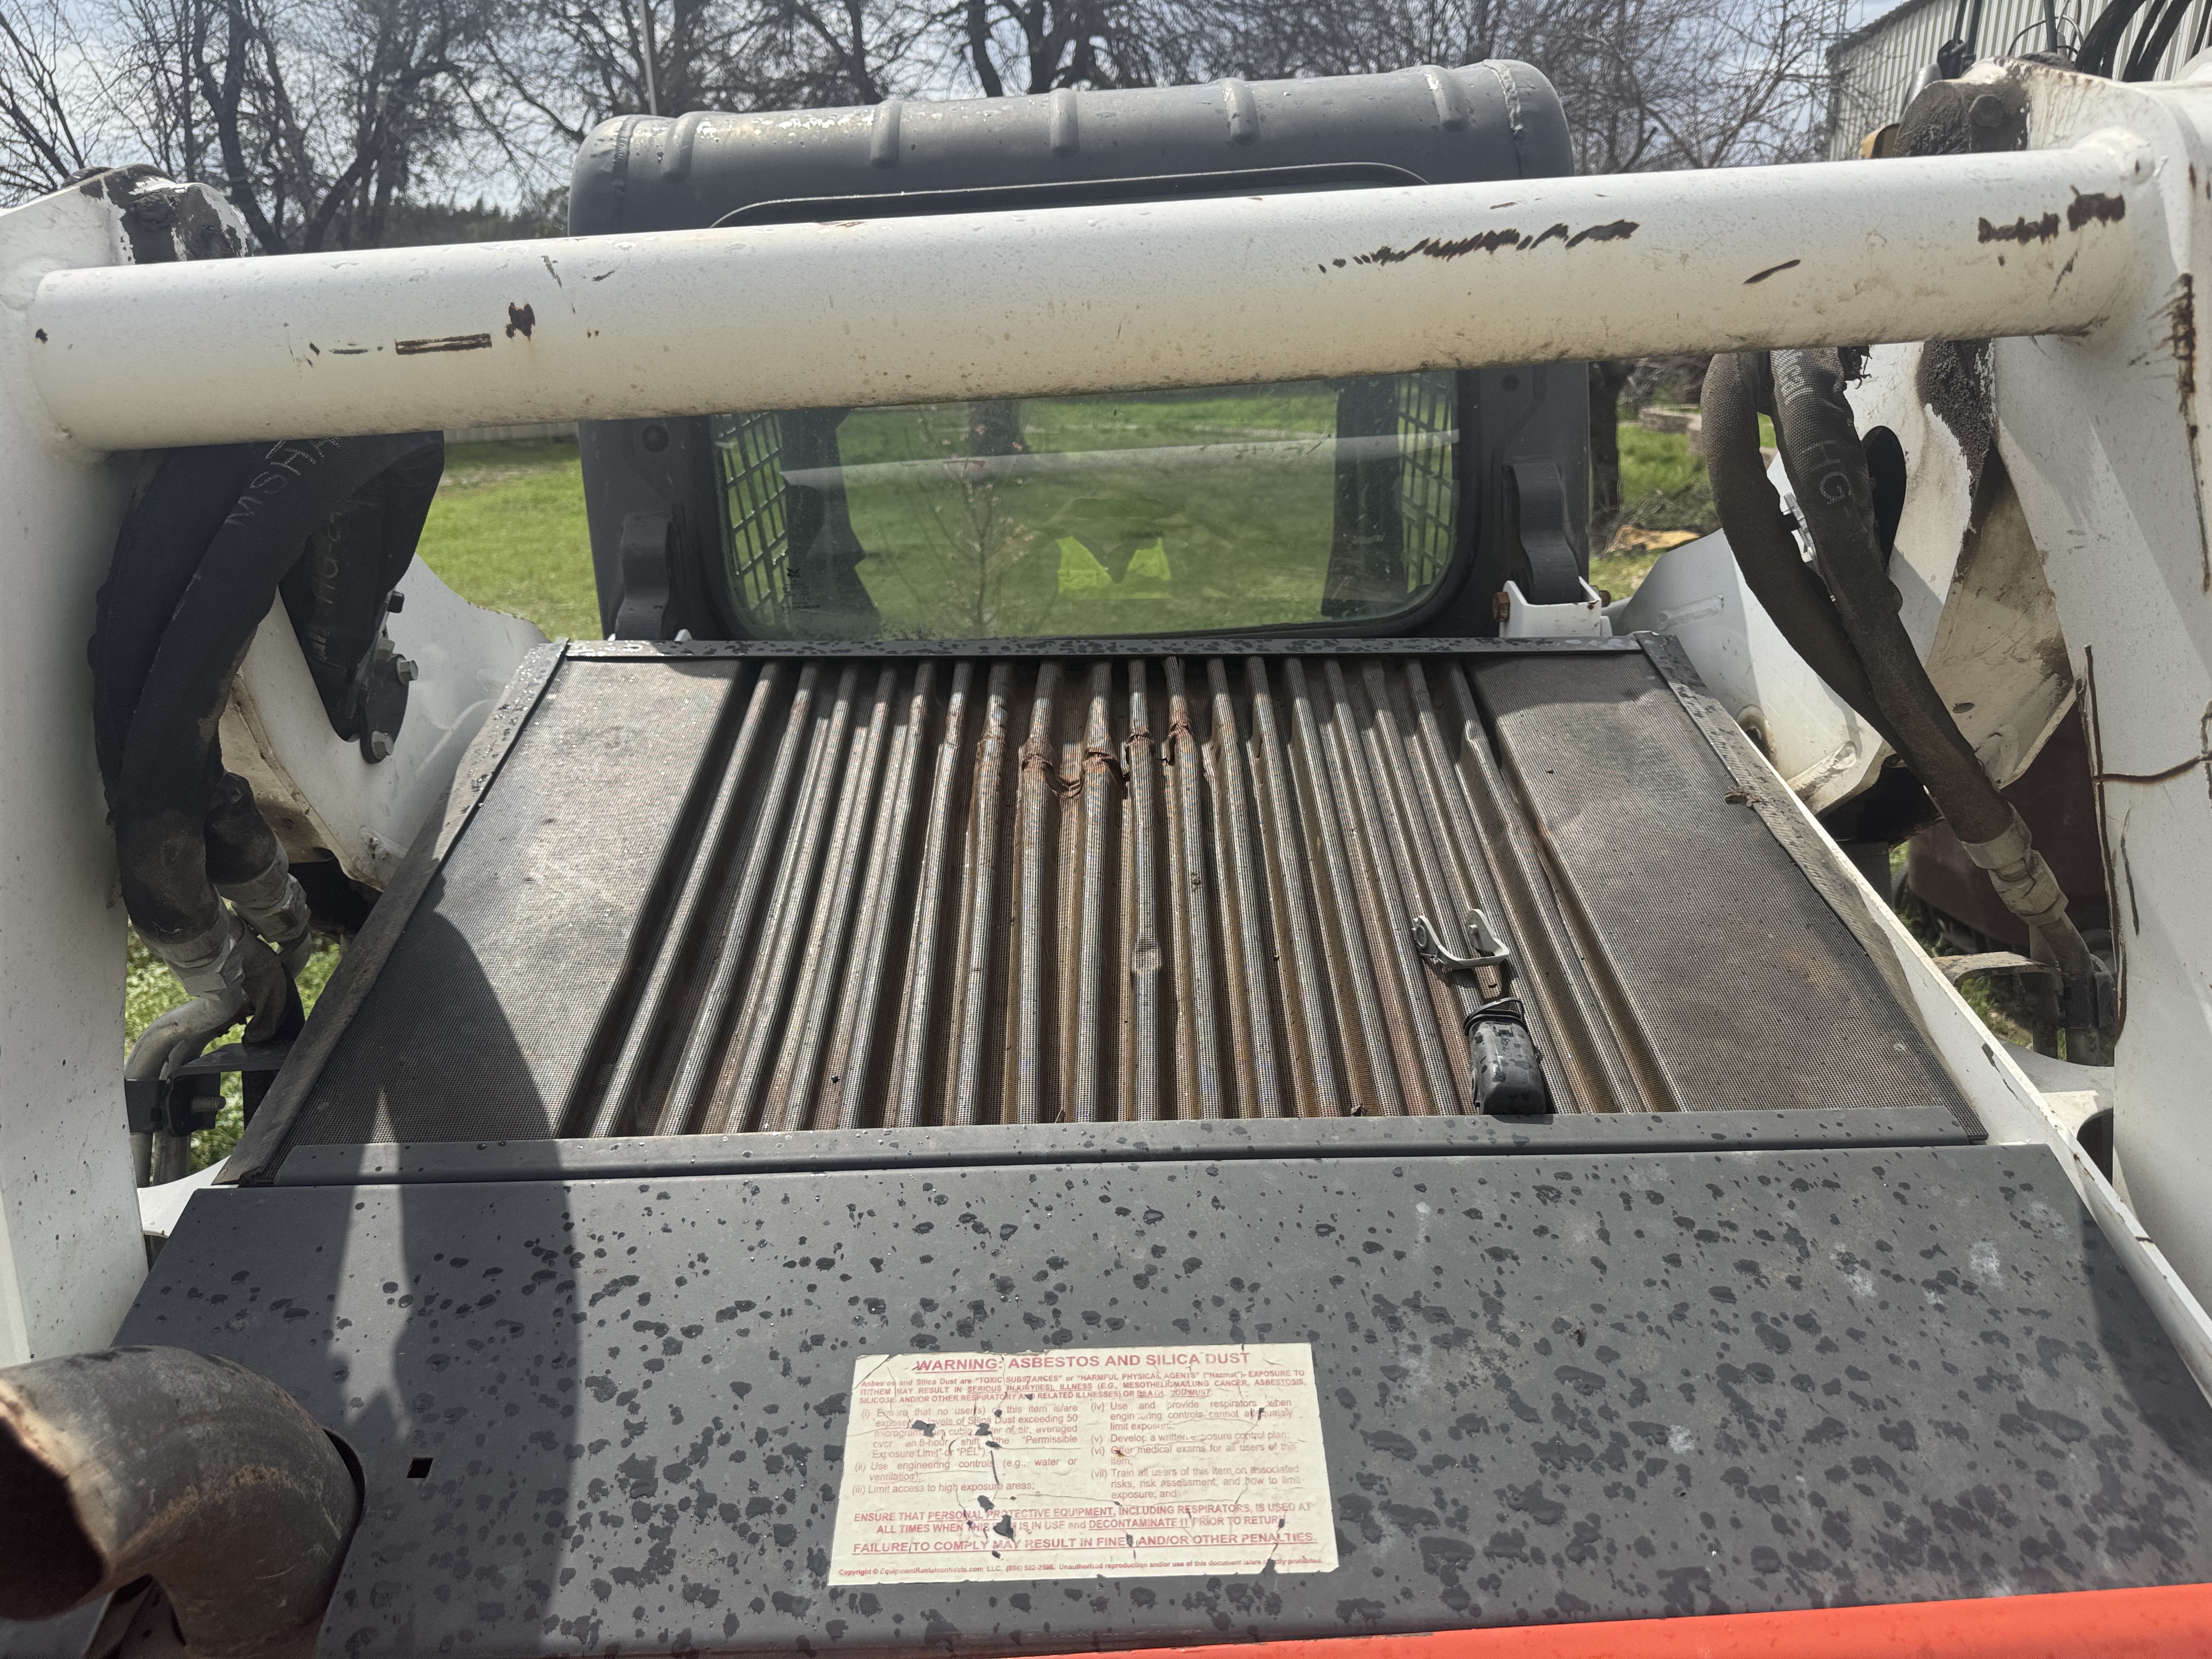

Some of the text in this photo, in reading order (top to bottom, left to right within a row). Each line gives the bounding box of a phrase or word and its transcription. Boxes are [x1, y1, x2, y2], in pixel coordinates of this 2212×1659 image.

[915, 1352, 1250, 1371] WARNING: ASBESTOS AND SILICA DUST
[1097, 1382, 1118, 1390] (E.G.,
[1254, 1378, 1306, 1386] ASBESTOSIS,
[1075, 1390, 1121, 1399] ILLNESSES)
[861, 1408, 871, 1419] (i)
[914, 1407, 932, 1415] that
[1006, 1404, 1023, 1413] this
[1029, 1404, 1047, 1413] item
[1053, 1403, 1077, 1412] is/are
[1091, 1402, 1104, 1412] (iv)
[1110, 1401, 1128, 1410] Use
[1138, 1401, 1155, 1409] and
[1210, 1398, 1257, 1410] respirators
[1267, 1397, 1291, 1407] when
[956, 1417, 966, 1425] of
[1018, 1414, 1063, 1425] exceeding
[1066, 1413, 1077, 1421] 50
[1167, 1409, 1203, 1419] controls
[1005, 1425, 1014, 1434] of
[1035, 1424, 1077, 1435] averaged
[1110, 1421, 1128, 1430] limit
[918, 1437, 948, 1447] 8-hour
[1022, 1434, 1077, 1444] "Permissible
[1091, 1434, 1103, 1444] (v)
[1234, 1431, 1265, 1440] control
[1267, 1430, 1290, 1441] plan;
[1091, 1446, 1105, 1457] (vi)
[1137, 1444, 1172, 1454] medical
[854, 1462, 866, 1472] (ii)
[871, 1462, 888, 1470] Use
[896, 1460, 950, 1471] engineering
[958, 1459, 993, 1468] controls
[1034, 1457, 1059, 1466] water
[1110, 1457, 1133, 1466] item;
[1111, 1468, 1134, 1477] Train
[1137, 1468, 1148, 1477] all
[1180, 1466, 1190, 1476] of
[1192, 1466, 1209, 1475] this
[1212, 1466, 1232, 1475] item
[1111, 1479, 1135, 1489] risks,
[1139, 1479, 1156, 1487] risk
[1160, 1477, 1218, 1488] assessment,
[1222, 1476, 1240, 1486] and
[1268, 1476, 1278, 1484] to
[1281, 1475, 1301, 1484] limit
[851, 1485, 866, 1496] (iii)
[868, 1484, 890, 1493] Limit
[927, 1483, 936, 1492] to
[938, 1482, 958, 1493] high
[960, 1482, 1003, 1493] exposure
[1006, 1482, 1035, 1491] areas;
[1111, 1489, 1177, 1500] exposure; and
[854, 1512, 896, 1522] ENSURE
[898, 1511, 925, 1521] THAT
[927, 1510, 983, 1520] PERSONAL
[1119, 1505, 1175, 1515] INCLUDING
[1255, 1503, 1265, 1512] IS
[1267, 1502, 1295, 1511] USED
[1297, 1502, 1312, 1511] AT
[876, 1525, 897, 1534] ALL
[898, 1523, 930, 1533] TIMES
[932, 1523, 963, 1532] WHEN
[1031, 1521, 1041, 1530] IN
[1045, 1520, 1065, 1530] USE
[1068, 1520, 1086, 1529] and
[1089, 1517, 1178, 1528] DECONTAMINATE
[1180, 1517, 1189, 1526] IT
[1227, 1516, 1242, 1525] TO
[853, 1532, 1317, 1553] FAILURE TO COMPLY MAY RESULT IN AND/OR OTHER PENALTIES.
[838, 1568, 872, 1577] Copyright
[1104, 1561, 1148, 1570] reproduction
